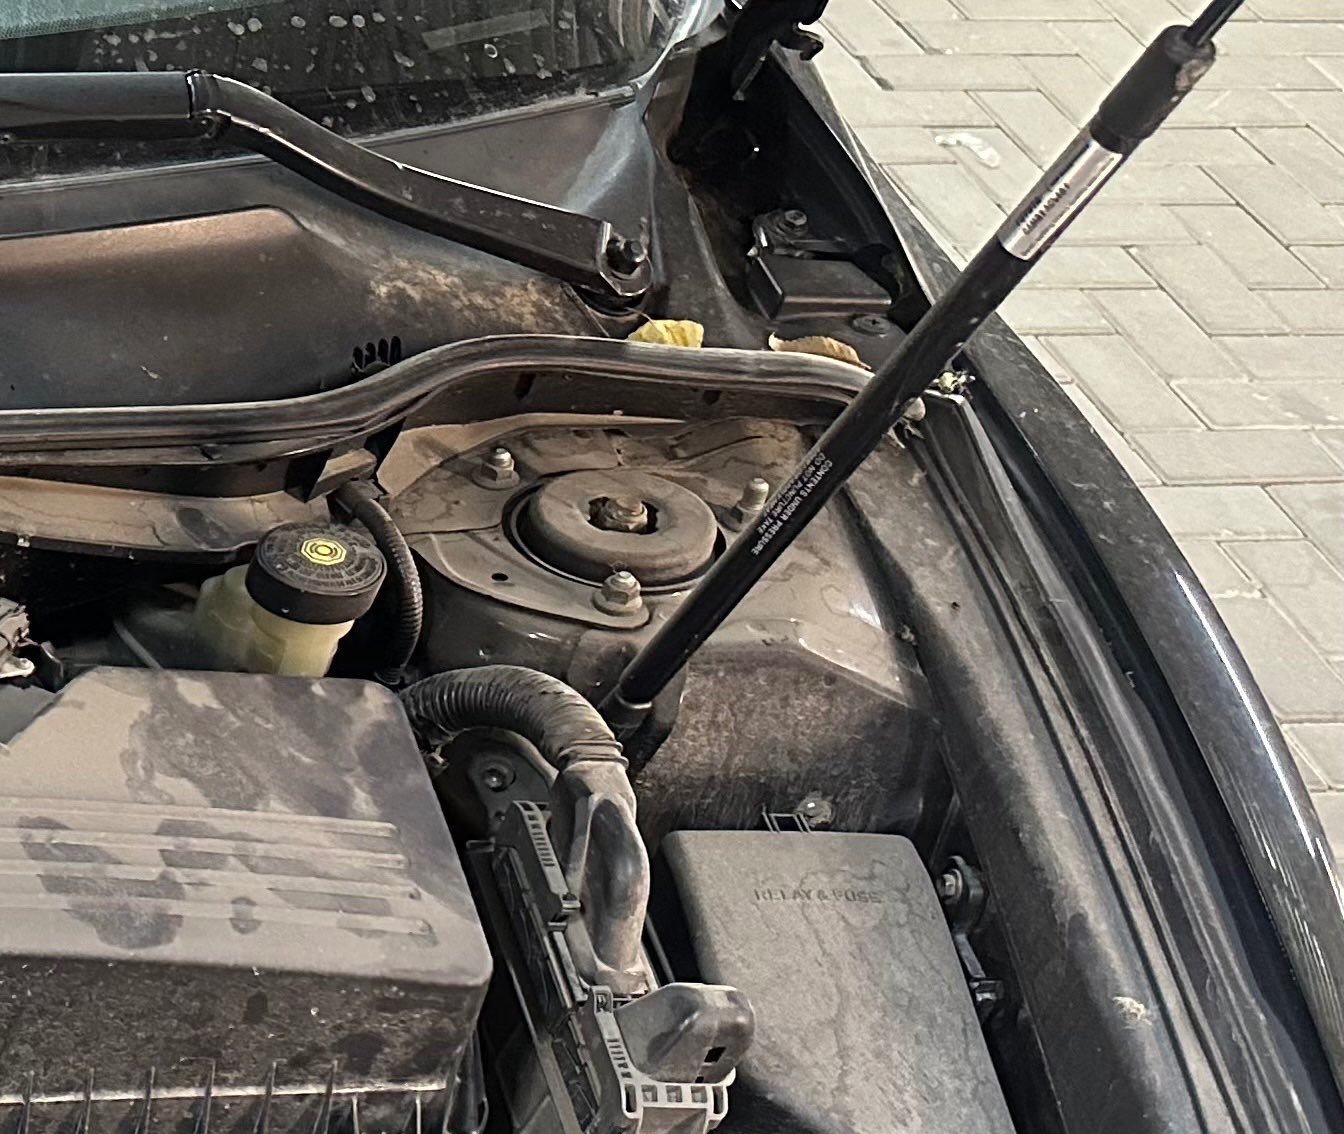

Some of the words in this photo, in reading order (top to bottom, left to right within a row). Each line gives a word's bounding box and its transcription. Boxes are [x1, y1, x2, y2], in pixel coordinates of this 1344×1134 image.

[799, 459, 833, 497] CONTENTS
[780, 496, 803, 521] UNDER
[751, 520, 784, 555] PRESSURE
[754, 888, 813, 902] RELAY
